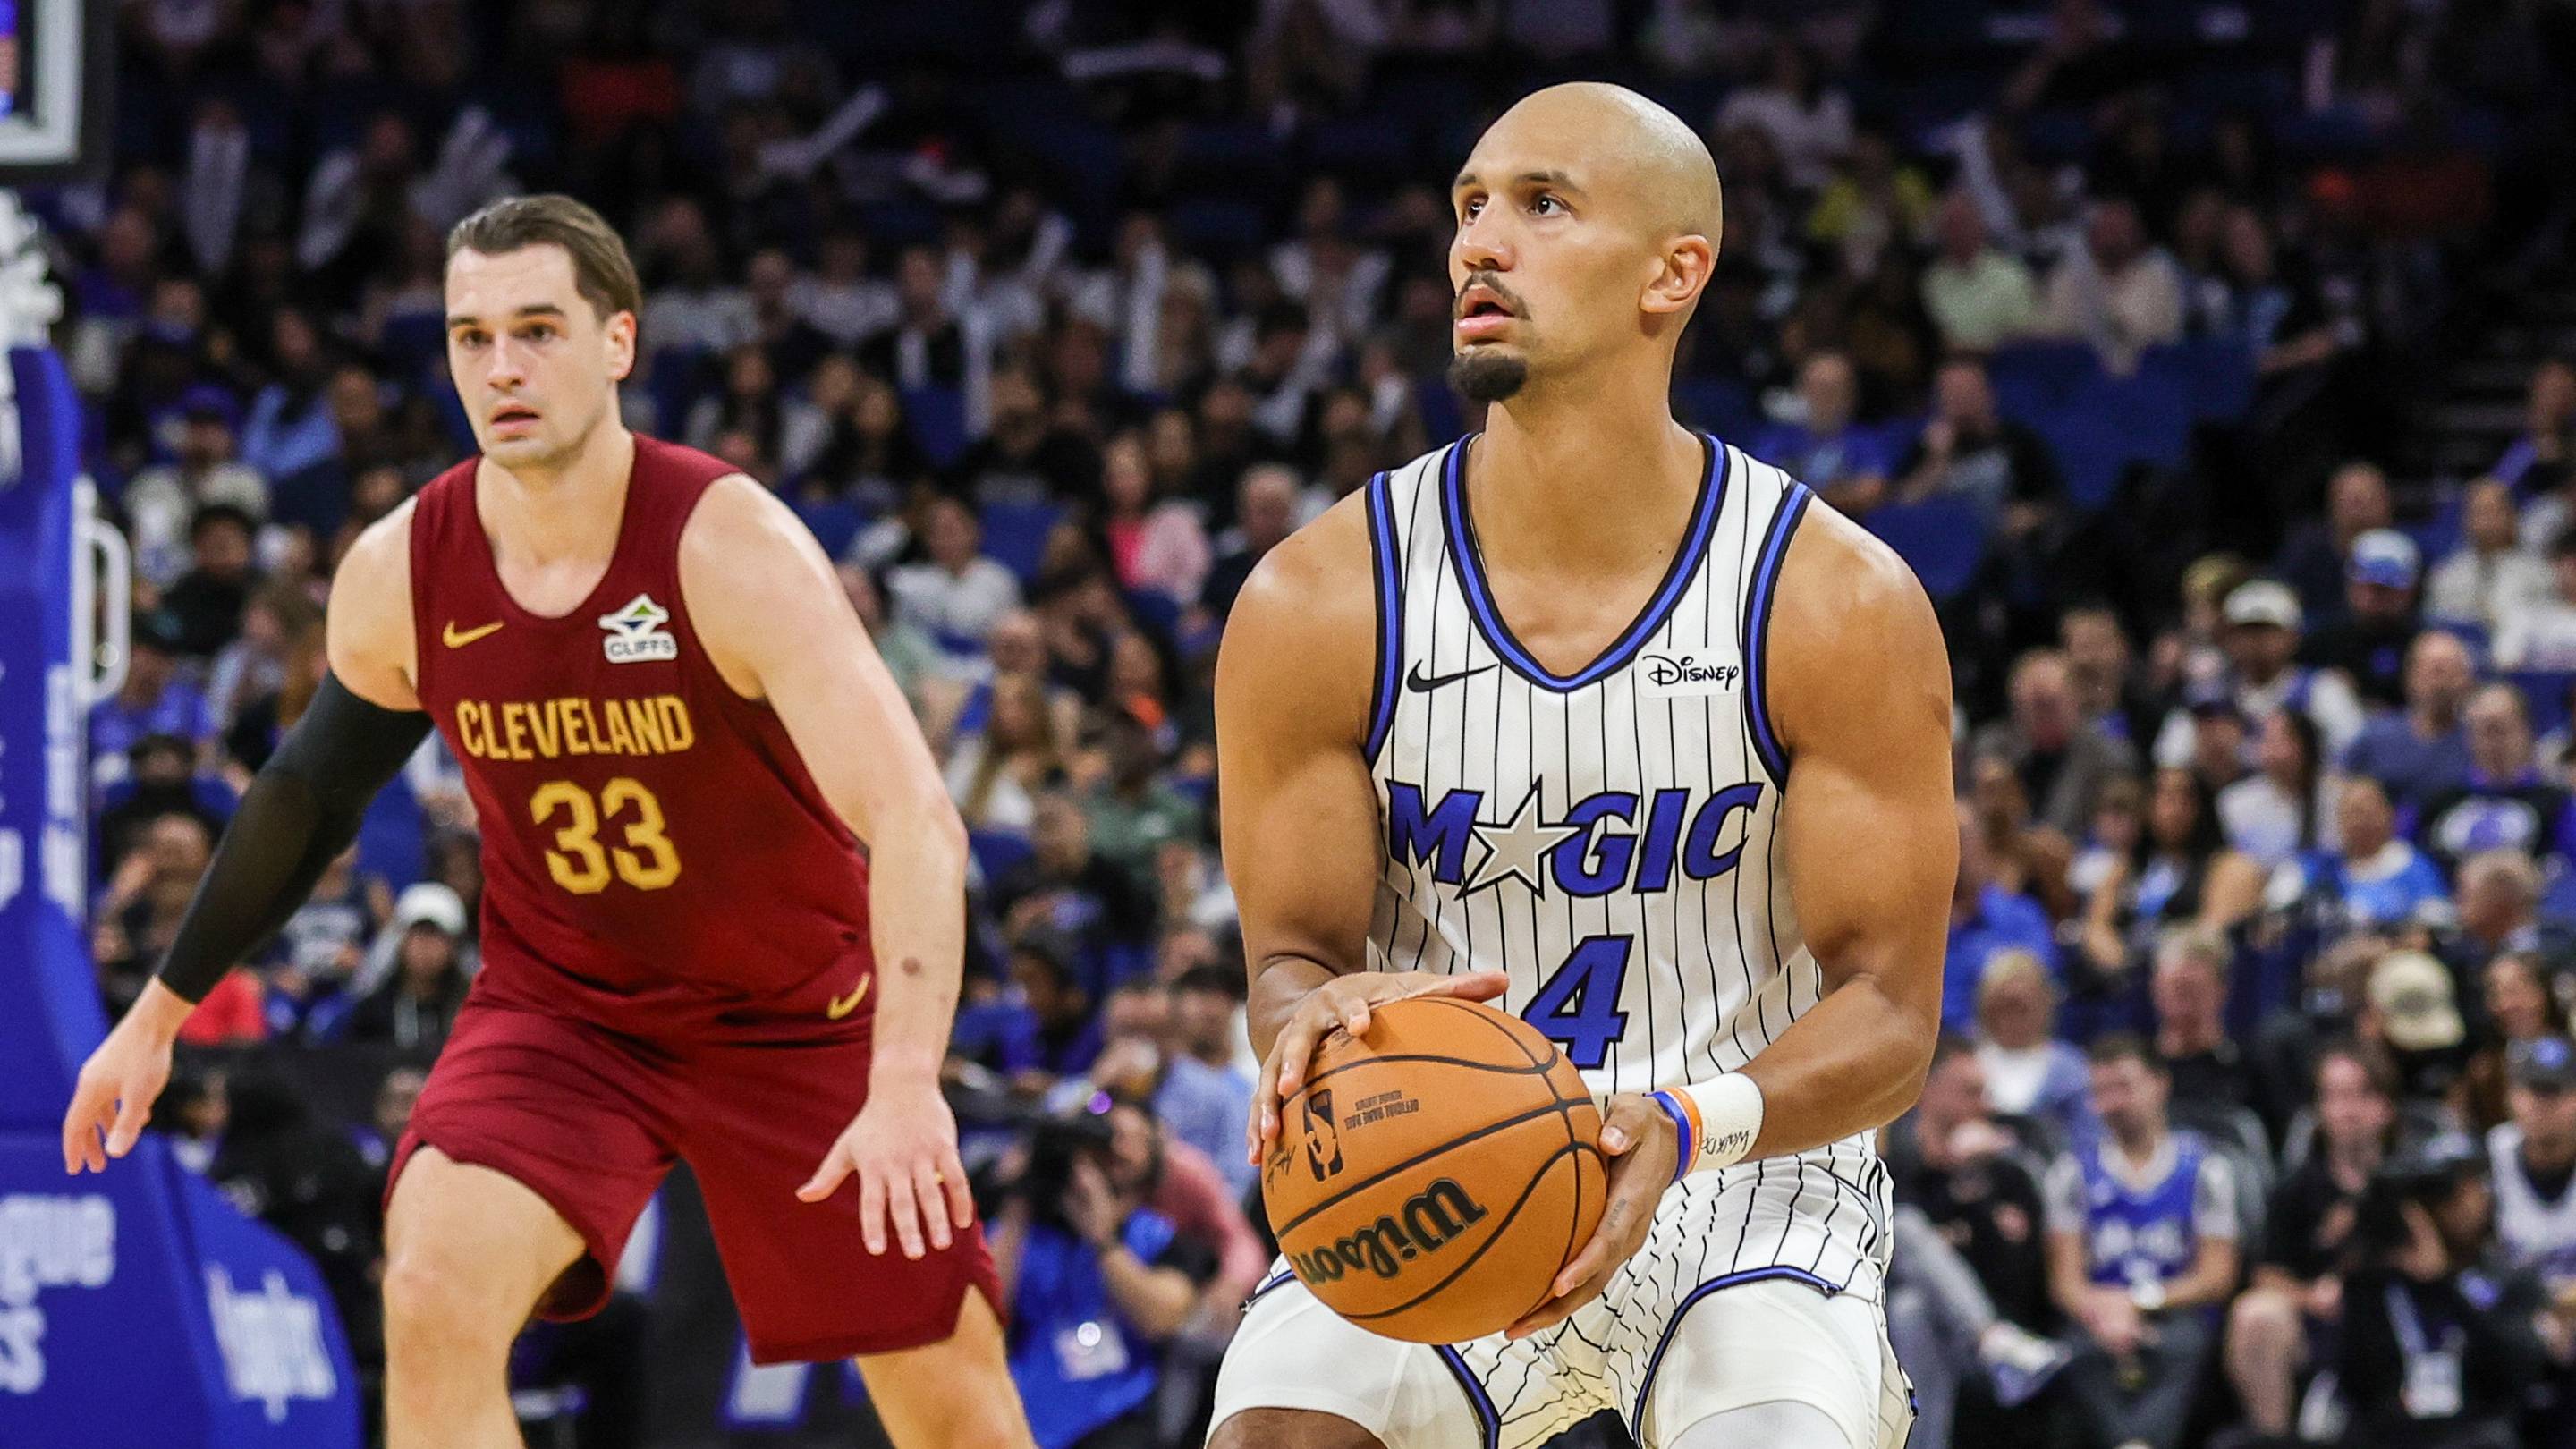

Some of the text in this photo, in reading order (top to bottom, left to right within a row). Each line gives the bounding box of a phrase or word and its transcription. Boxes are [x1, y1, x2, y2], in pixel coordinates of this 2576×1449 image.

[608, 640, 674, 657] CLIFFS
[455, 695, 695, 760] CLEVELAND
[530, 777, 682, 895] 33
[1521, 934, 1635, 1071] 4
[1292, 1176, 1489, 1285] Wilson
